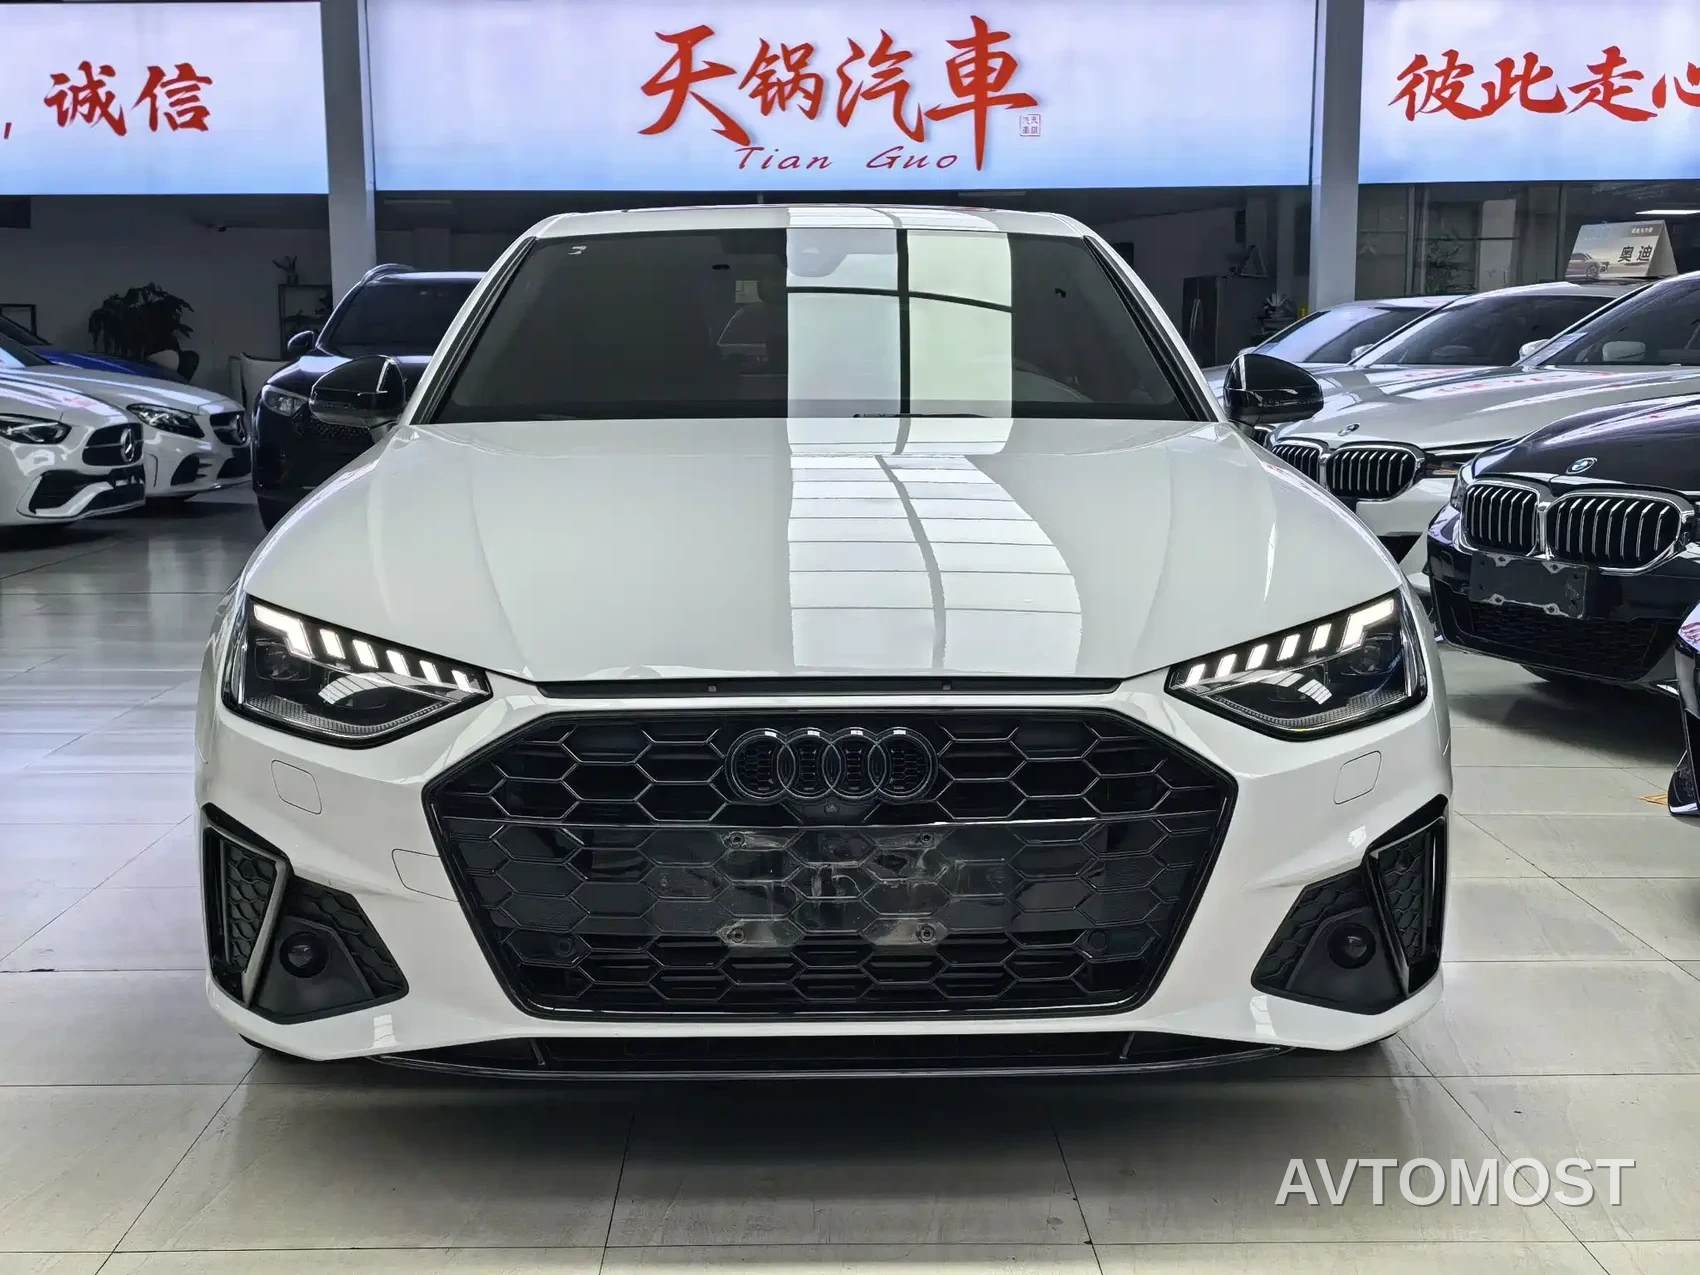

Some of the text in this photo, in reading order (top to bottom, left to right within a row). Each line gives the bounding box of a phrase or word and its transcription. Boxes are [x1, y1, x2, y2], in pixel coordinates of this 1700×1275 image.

[43, 60, 213, 137] 诚信
[735, 145, 958, 170] Tian Guo
[1617, 245, 1653, 263] 奥迪
